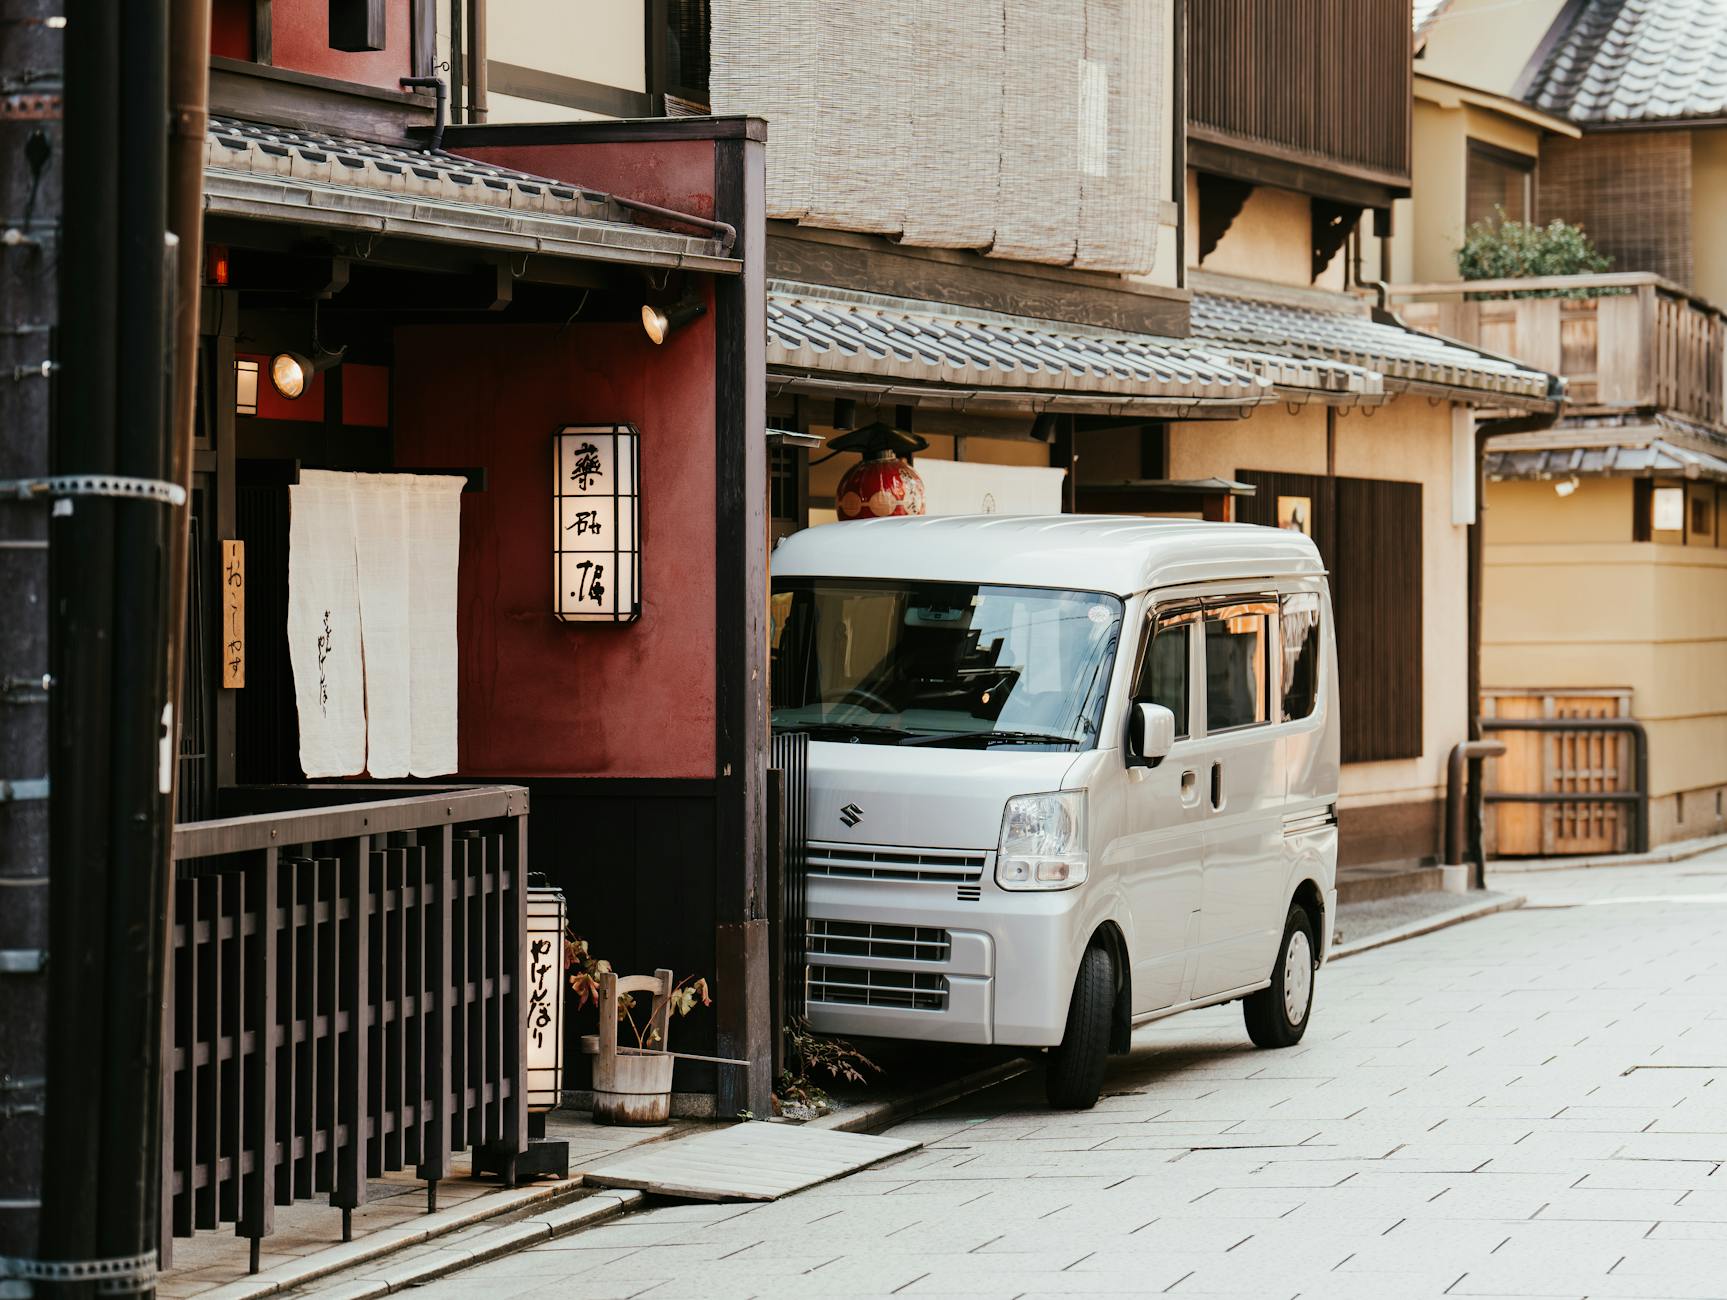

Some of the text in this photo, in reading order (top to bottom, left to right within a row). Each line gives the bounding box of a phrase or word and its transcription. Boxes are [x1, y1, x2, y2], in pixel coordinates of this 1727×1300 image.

[527, 939, 552, 1049] やげんぼり
